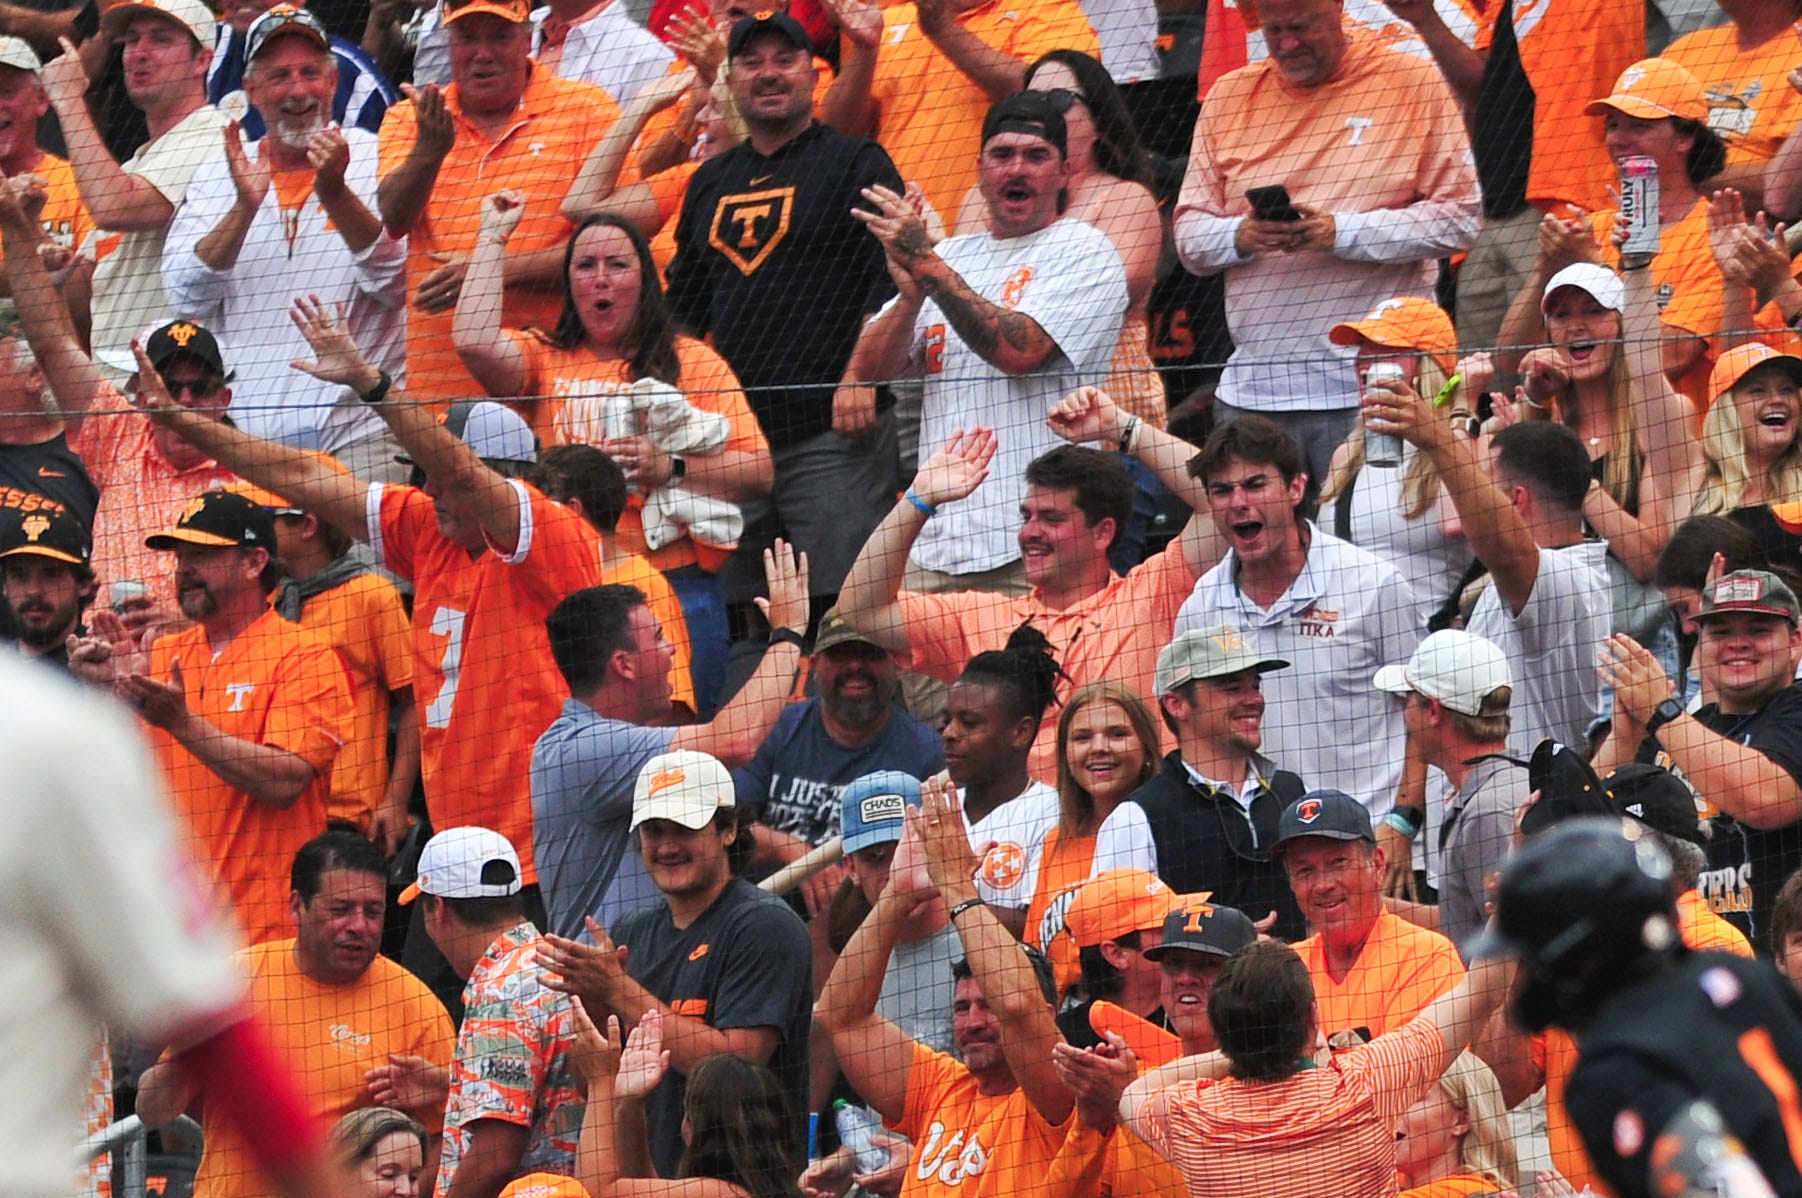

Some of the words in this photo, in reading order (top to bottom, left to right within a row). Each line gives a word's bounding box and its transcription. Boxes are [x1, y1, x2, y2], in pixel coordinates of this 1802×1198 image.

[1343, 117, 1373, 146] T
[1622, 181, 1634, 225] RULY
[731, 204, 772, 248] T
[426, 607, 466, 728] 7
[226, 684, 254, 712] T
[863, 797, 902, 812] CHAOS
[1181, 905, 1214, 932] T
